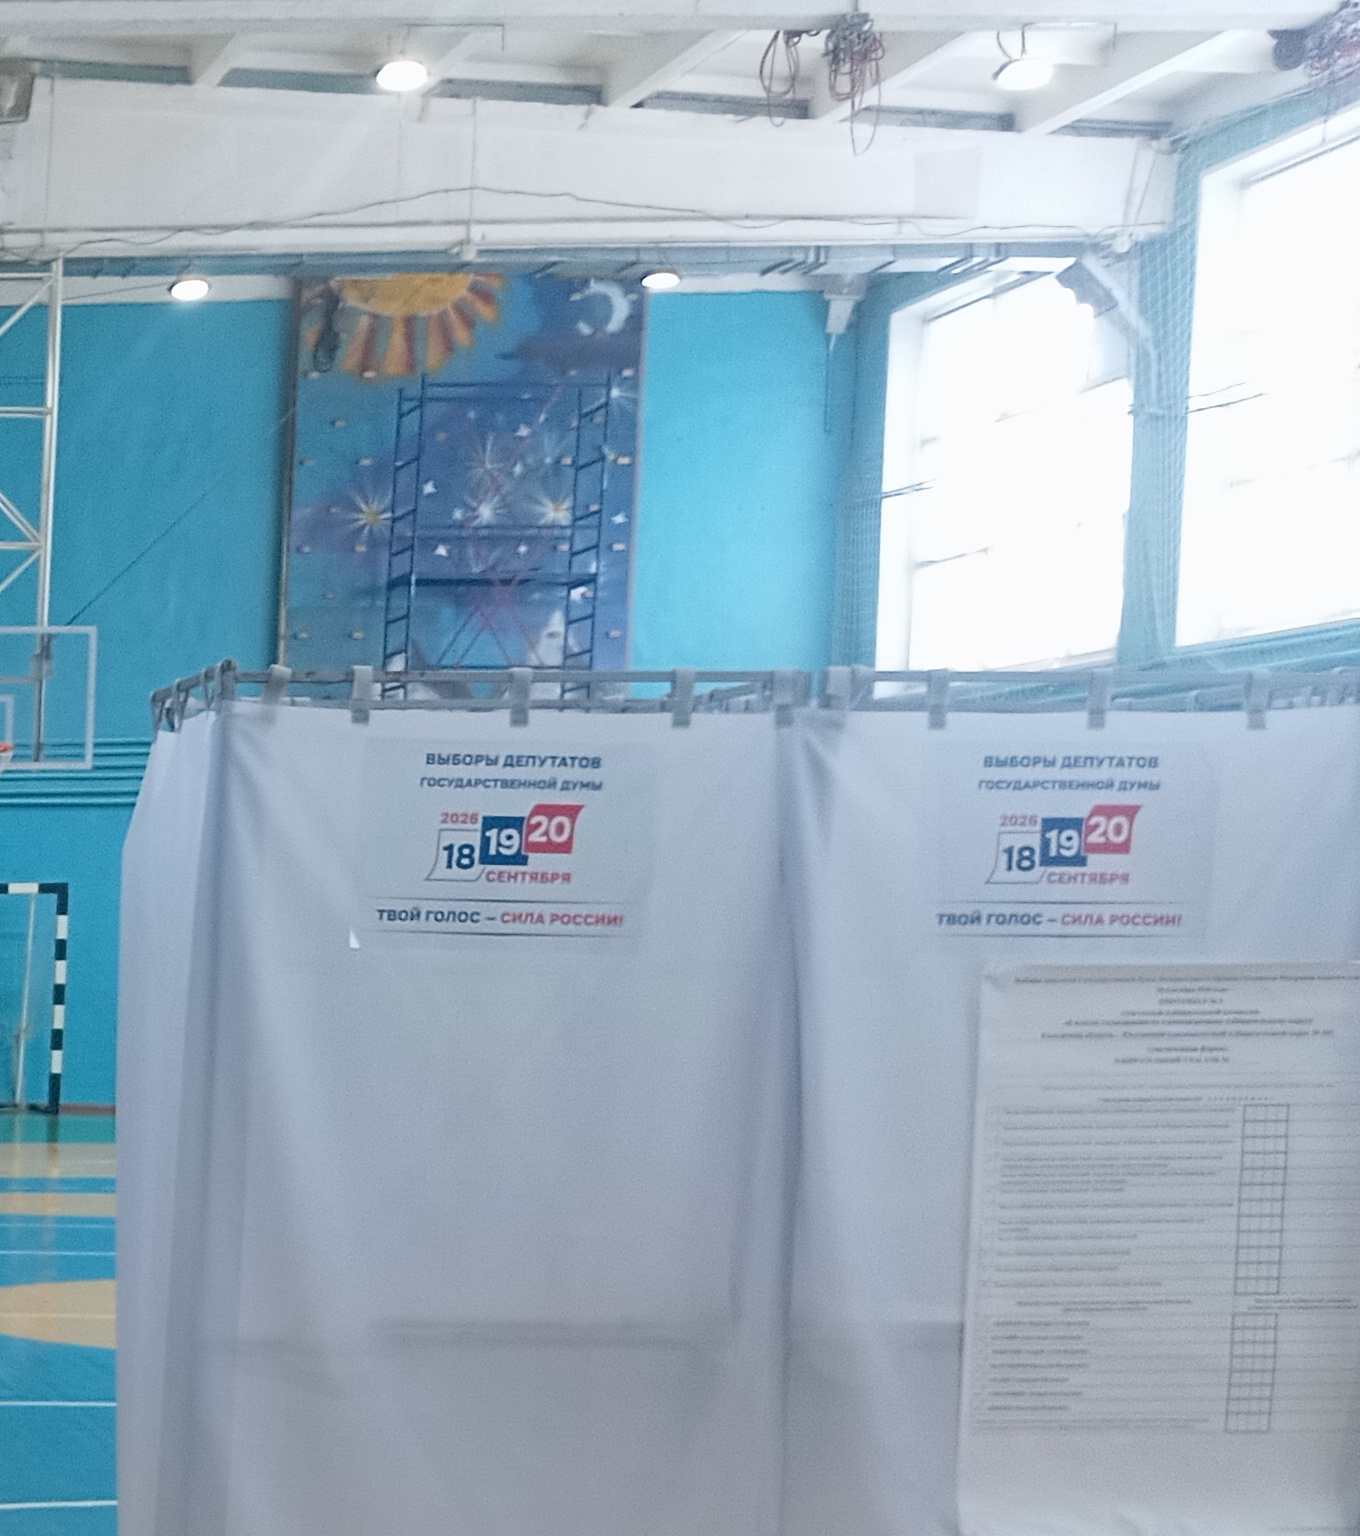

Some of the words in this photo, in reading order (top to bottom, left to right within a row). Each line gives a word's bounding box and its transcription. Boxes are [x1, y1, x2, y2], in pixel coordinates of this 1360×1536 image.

[425, 752, 500, 767] ВЫБОРЫ
[502, 755, 603, 769] ДЕПУТАТОВ
[983, 756, 1057, 769] ВЫБОРЫ
[1060, 756, 1160, 769] ДЕПУТАТОВ
[419, 776, 557, 791] ГОСУДАРСТВЕННОЙ
[559, 779, 604, 793] ДУМЫ
[978, 779, 1116, 792] ГОСУДАРСТВЕННОЙ
[1118, 779, 1161, 792] ДУМЫ
[440, 812, 479, 825] 2026
[999, 814, 1038, 827] 2026
[441, 843, 476, 870] 18
[484, 828, 521, 856] 19
[528, 815, 571, 843] 20
[1002, 845, 1037, 872] 18
[1044, 828, 1080, 857] 19
[1086, 815, 1130, 843] 20
[485, 871, 572, 884] СЕНТЯБРЯ
[1046, 872, 1130, 885] СЕНТЯБРЯ
[376, 907, 421, 923] ТВОЙ
[425, 909, 481, 924] ГОЛОС
[500, 911, 545, 926] СИЛА
[549, 912, 624, 927] РОССИИ!
[937, 911, 982, 926] ТВОЙ
[986, 913, 1043, 926] ГОЛОС
[1061, 913, 1105, 927] СИЛА
